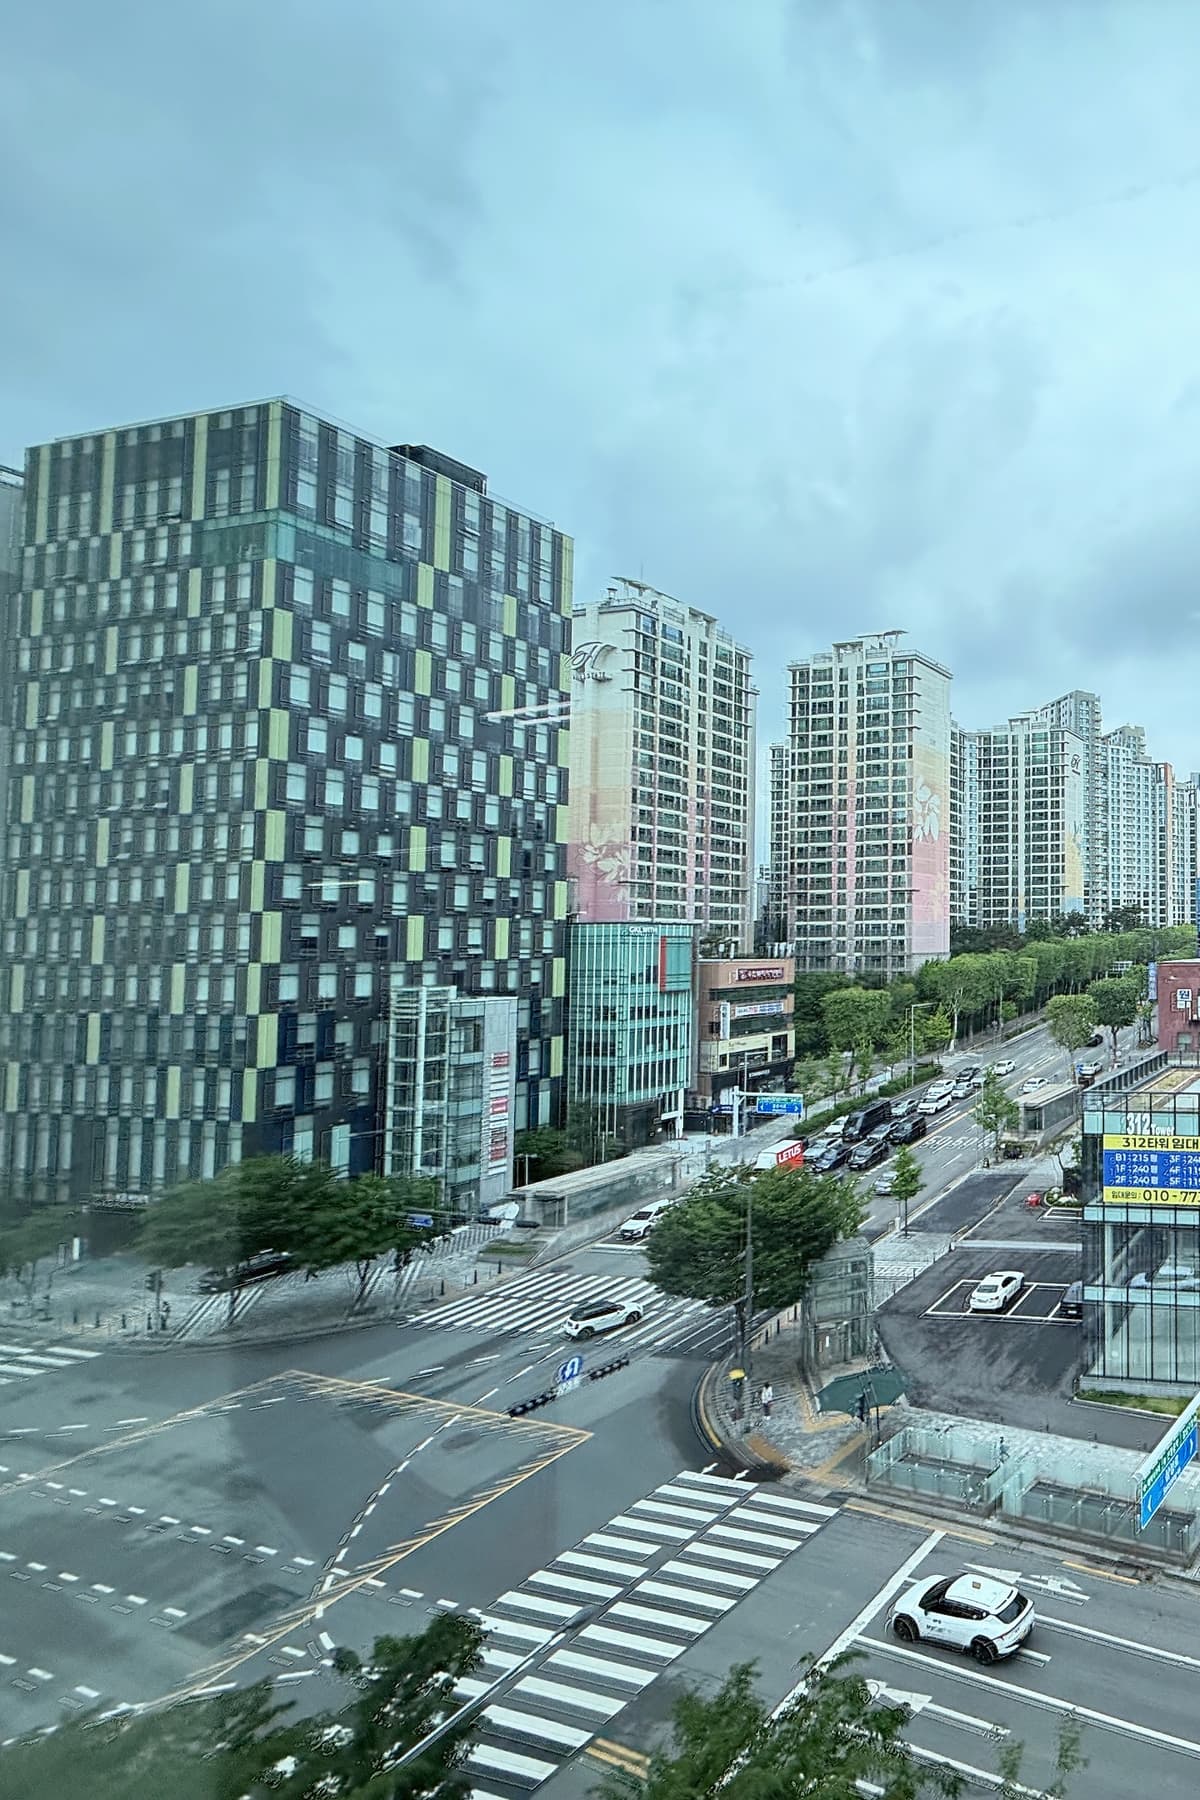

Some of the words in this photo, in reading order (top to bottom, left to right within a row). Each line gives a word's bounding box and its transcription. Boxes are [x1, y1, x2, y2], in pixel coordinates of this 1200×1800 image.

[1127, 1112, 1150, 1135] 312
[1122, 1138, 1169, 1149] 312타워
[1172, 1138, 1199, 1150] 임대
[778, 1143, 801, 1163] LETUS
[1115, 1154, 1127, 1162] B1
[1169, 1155, 1181, 1163] 3F
[1115, 1165, 1127, 1173] 1F
[1169, 1166, 1181, 1174] 4F
[1115, 1175, 1127, 1183] 2F
[1169, 1177, 1181, 1185] 5F
[1143, 1190, 1169, 1202] 010
